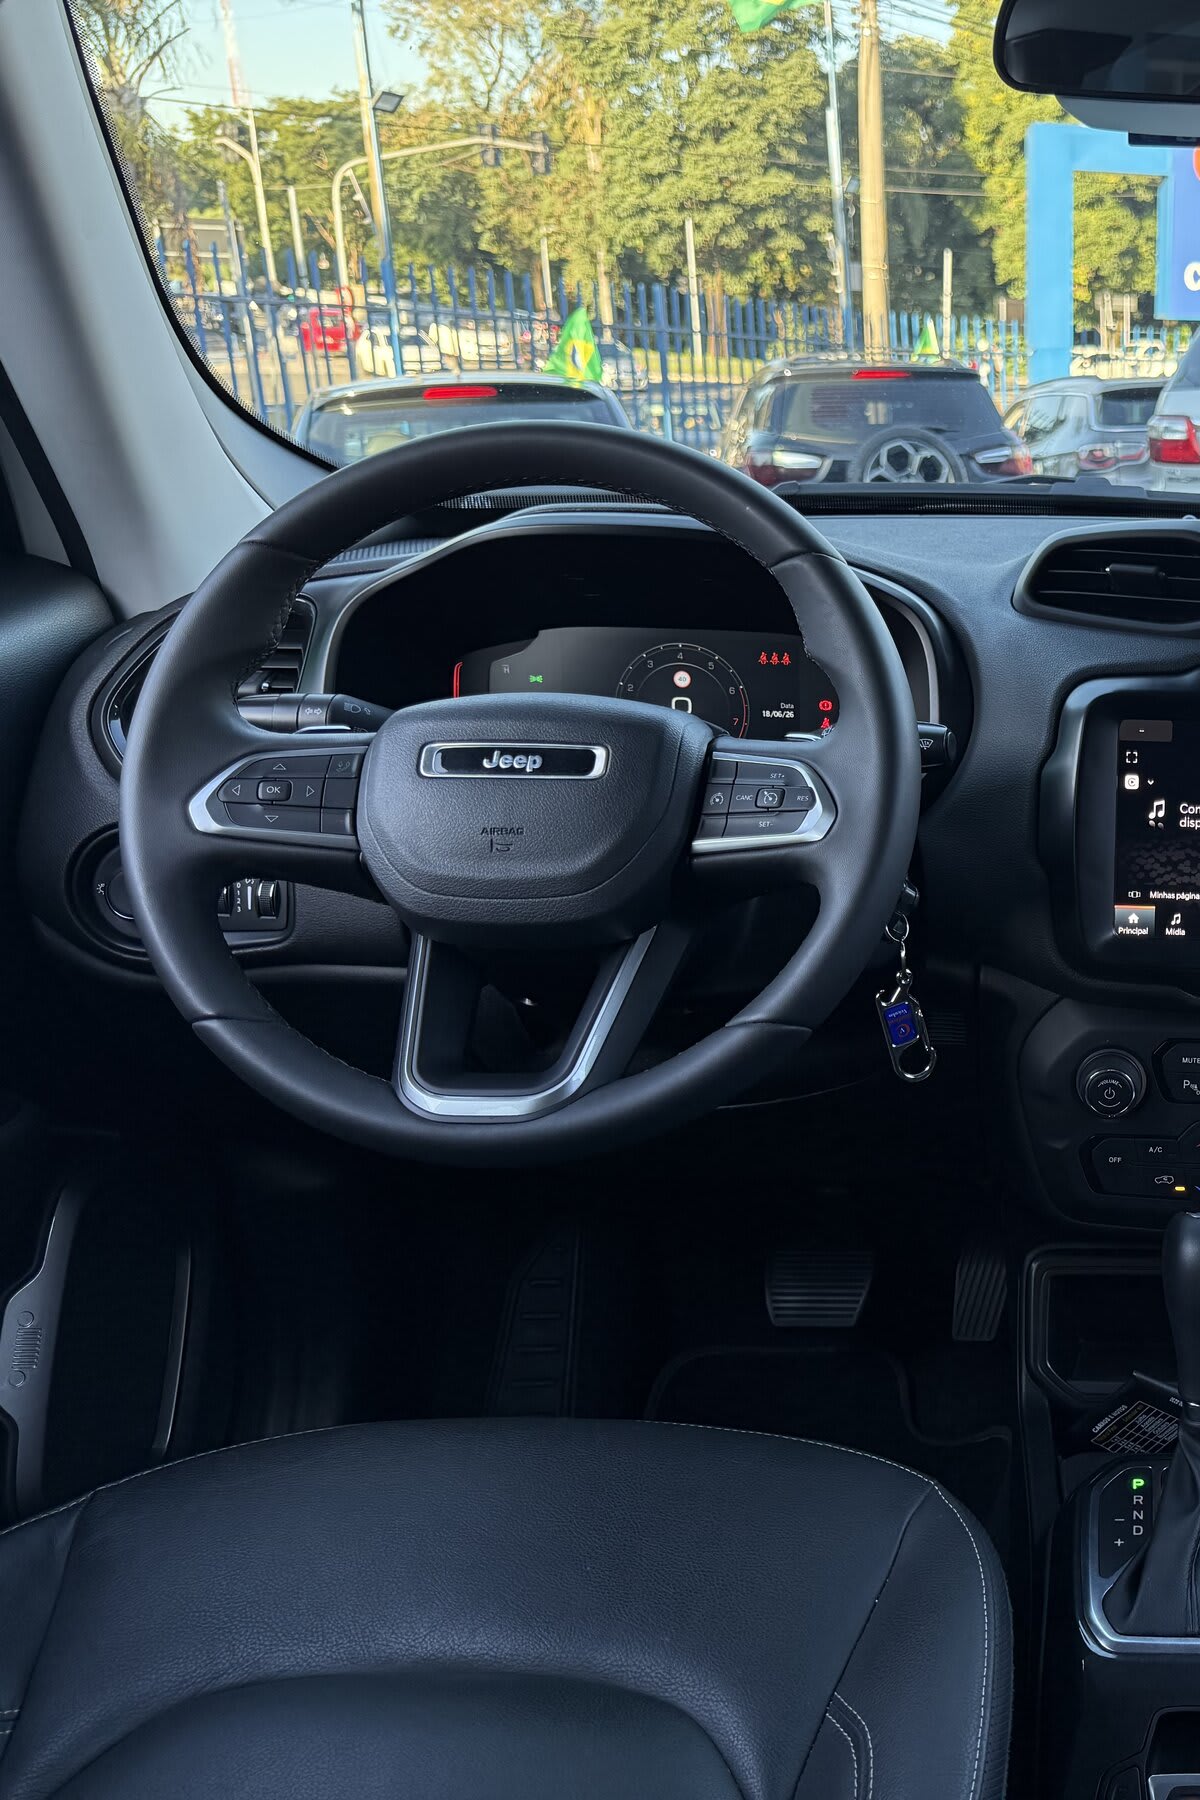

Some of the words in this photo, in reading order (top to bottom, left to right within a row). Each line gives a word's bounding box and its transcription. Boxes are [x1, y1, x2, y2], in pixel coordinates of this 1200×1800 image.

[482, 749, 543, 773] Jeep
[266, 786, 281, 794] OK
[480, 827, 525, 836] AIRBAG
[1149, 890, 1175, 899] Minhas
[1118, 926, 1149, 936] Principal
[1165, 928, 1186, 936] Mídia
[1132, 1478, 1145, 1490] P
[1133, 1495, 1144, 1505] R
[1133, 1510, 1144, 1520] N
[1133, 1525, 1144, 1536] D
